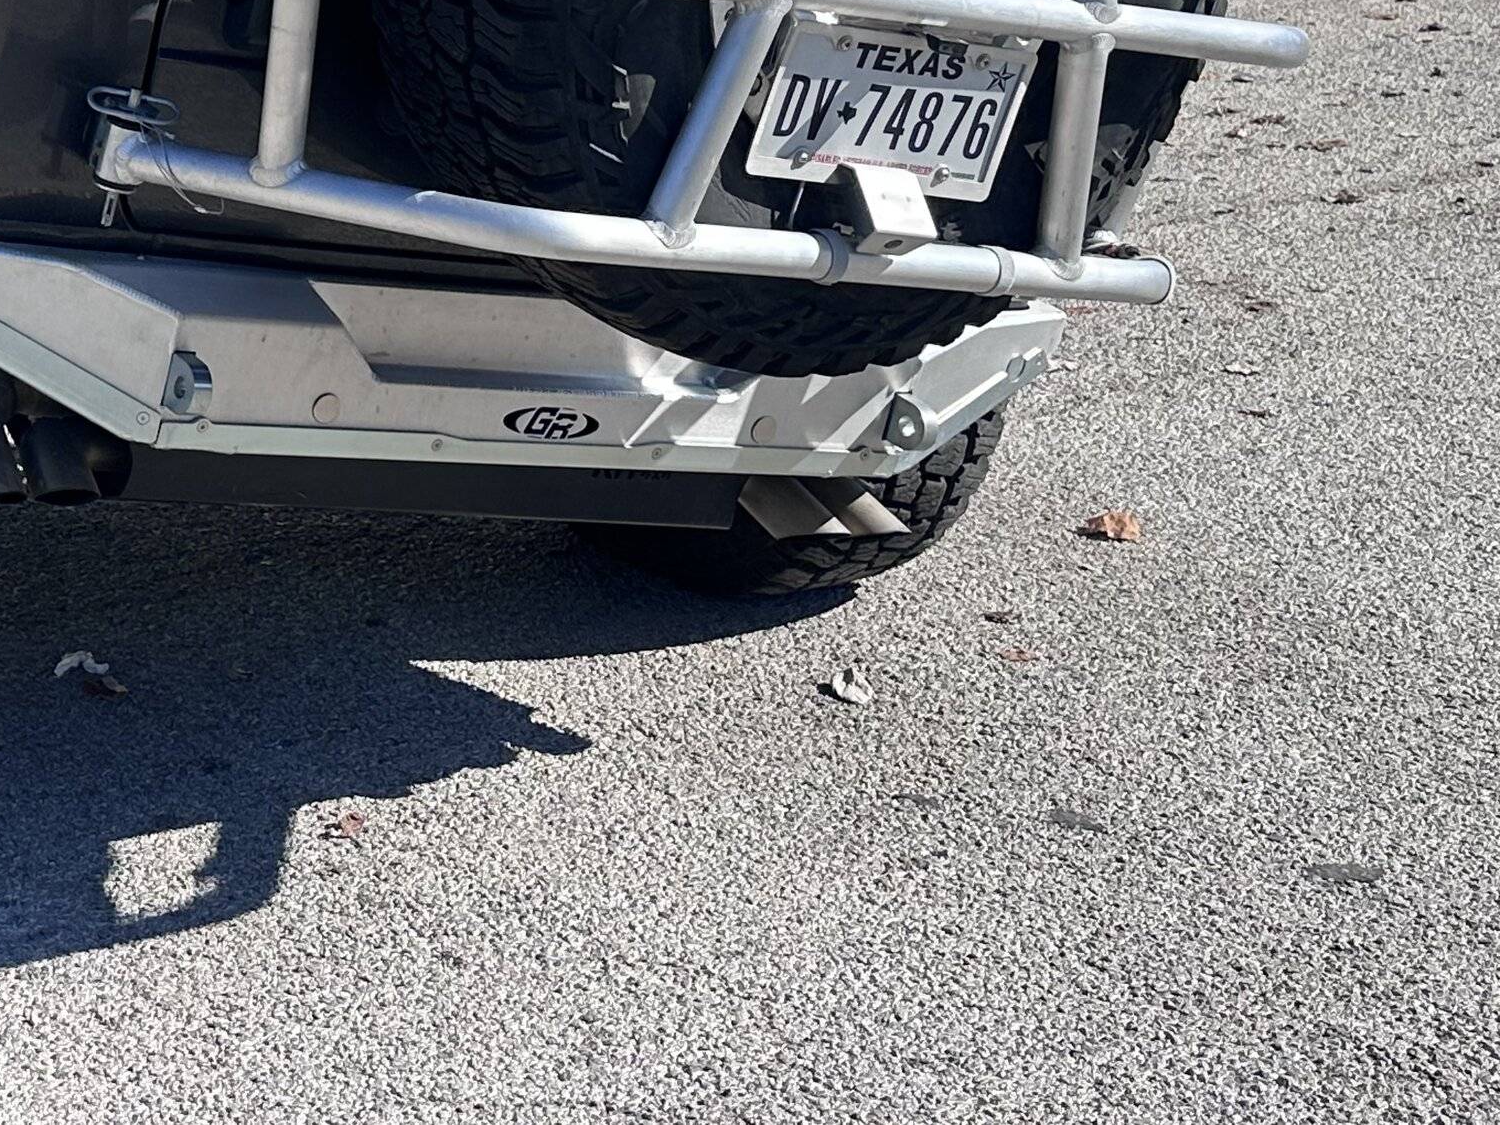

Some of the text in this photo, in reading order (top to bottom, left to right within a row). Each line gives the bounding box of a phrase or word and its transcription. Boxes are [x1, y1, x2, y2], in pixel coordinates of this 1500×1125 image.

[856, 42, 967, 80] TEXAS
[772, 73, 998, 160] DV 74876
[524, 406, 579, 440] GR
